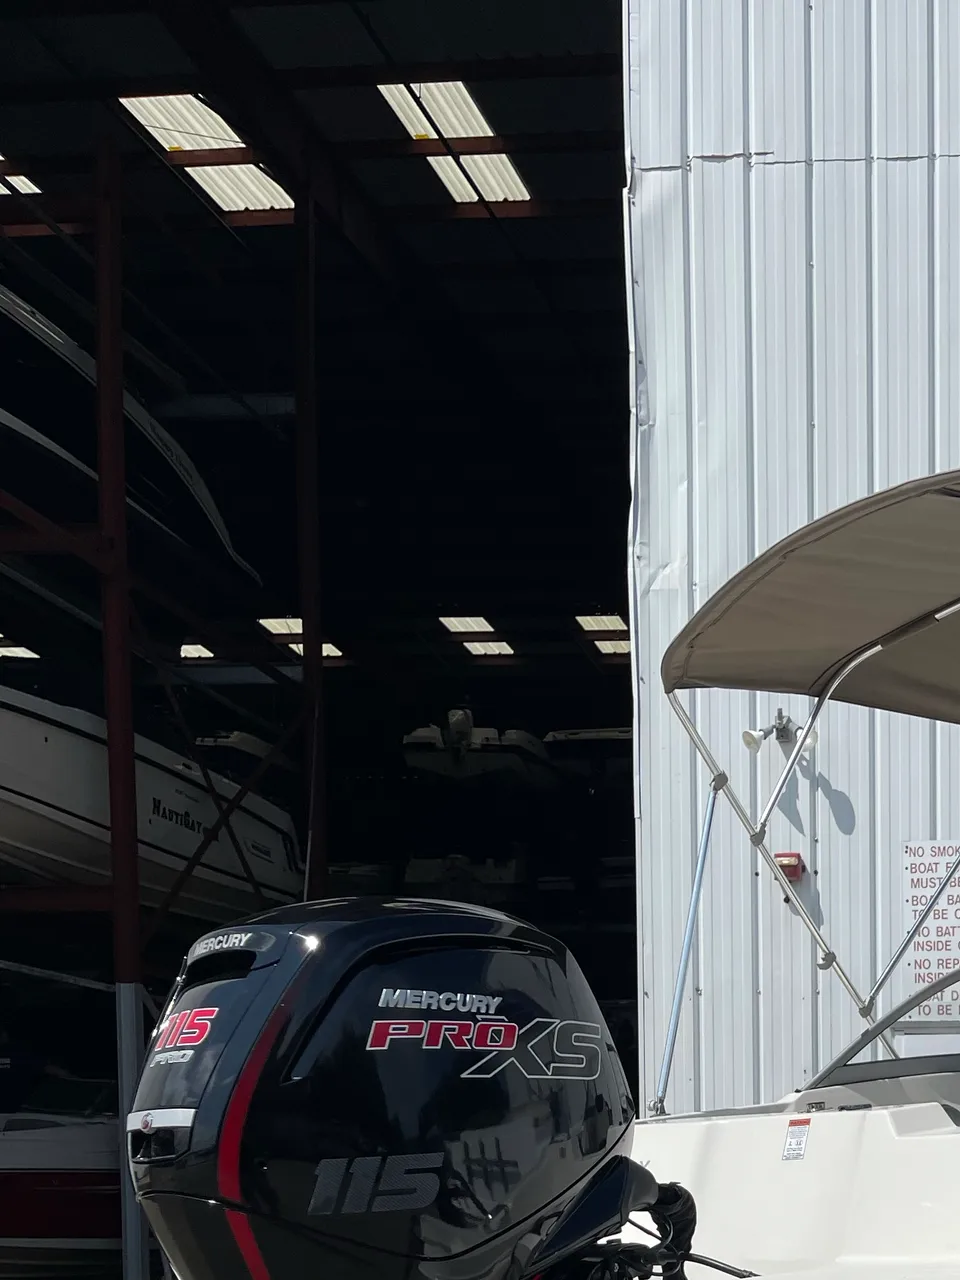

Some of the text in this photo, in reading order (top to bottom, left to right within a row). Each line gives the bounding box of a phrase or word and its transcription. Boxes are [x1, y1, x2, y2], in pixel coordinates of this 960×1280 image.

[909, 846, 925, 858] NO
[910, 862, 940, 874] BOAT
[910, 877, 943, 889] MUST
[911, 895, 939, 906] BO
[933, 908, 948, 920] BE
[916, 926, 930, 937] O
[193, 932, 253, 956] MERCURY
[913, 940, 954, 952] INSIDE
[914, 958, 931, 970] NO
[914, 972, 949, 984] INSI
[378, 988, 503, 1015] MERCURY
[917, 1004, 932, 1016] TO
[937, 1004, 952, 1016] BE
[154, 1007, 220, 1052] 115
[366, 1015, 601, 1080] PRO XS
[307, 1152, 445, 1216] 115
